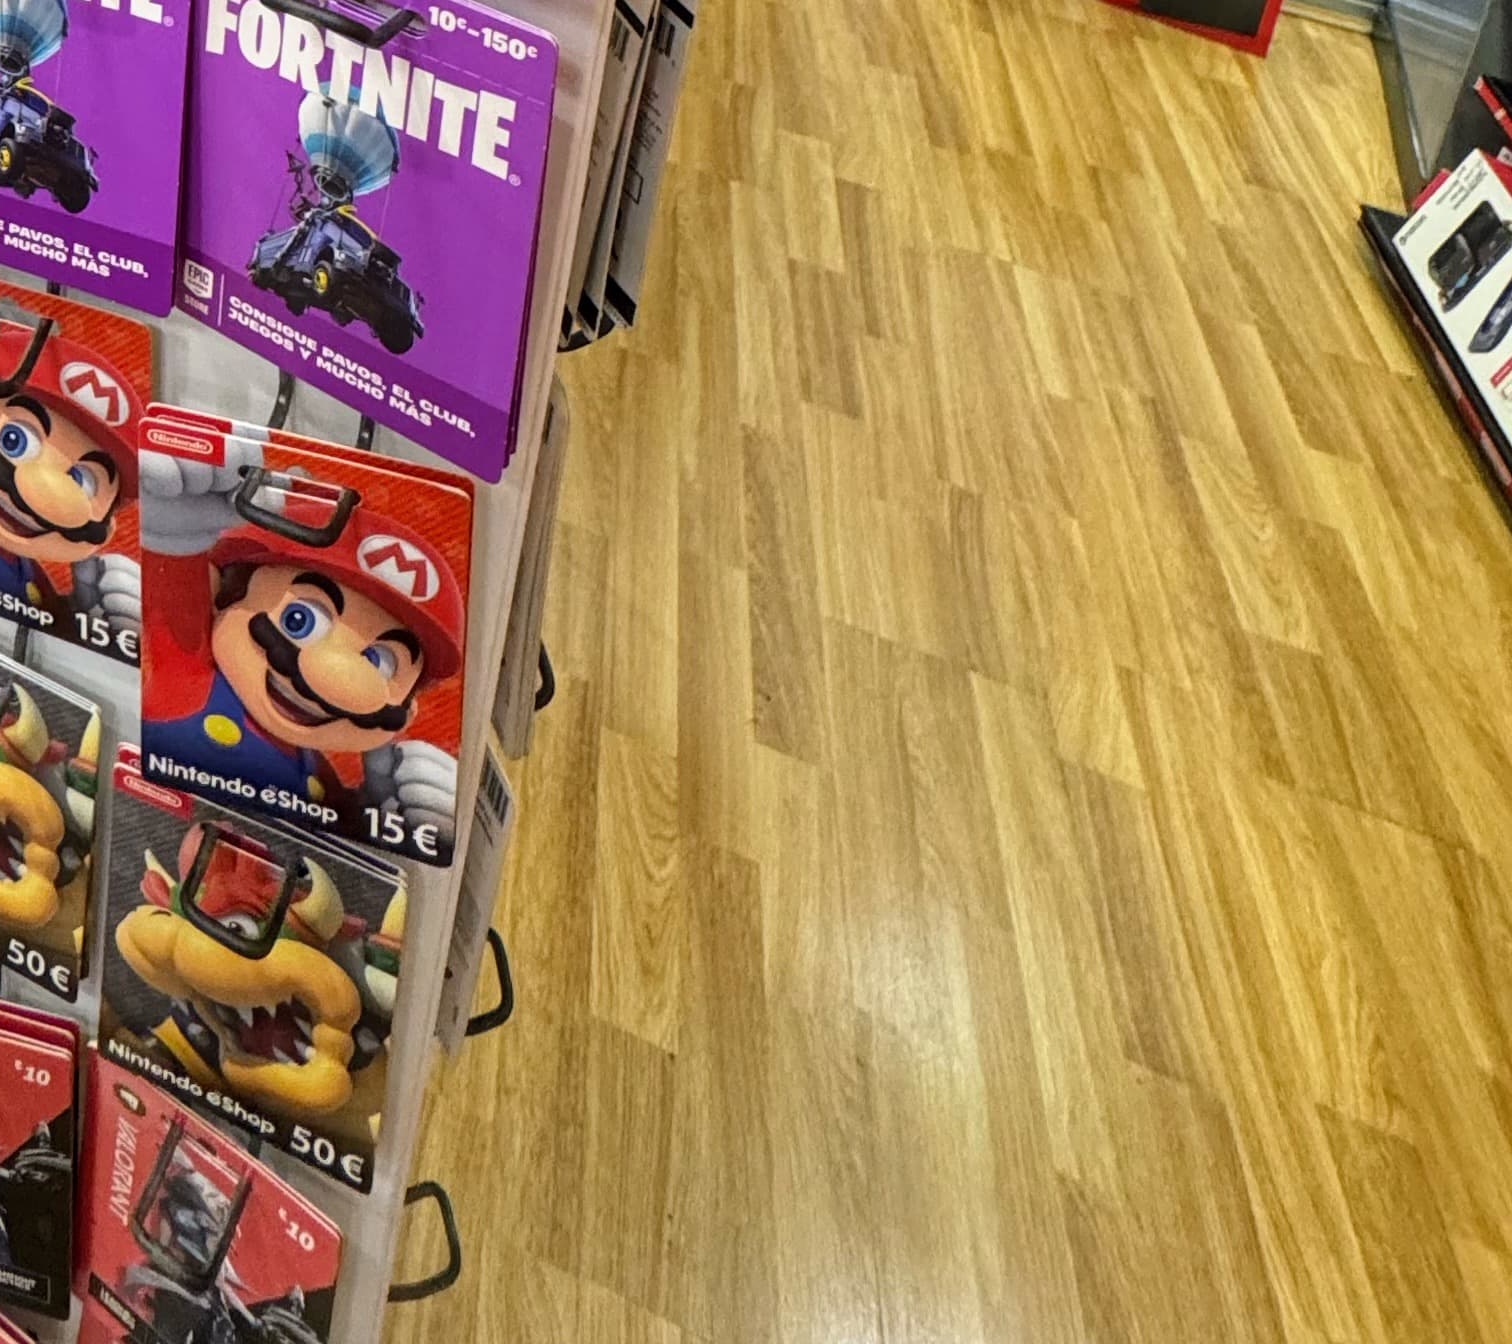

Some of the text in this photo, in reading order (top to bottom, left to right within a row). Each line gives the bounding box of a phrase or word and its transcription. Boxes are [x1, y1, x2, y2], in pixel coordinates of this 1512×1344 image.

[149, 753, 255, 798] Nintendo
[260, 783, 338, 825] eShop
[108, 1039, 202, 1096] Nintendo
[205, 1090, 276, 1135] eShop
[110, 1116, 138, 1226] VALORANT
